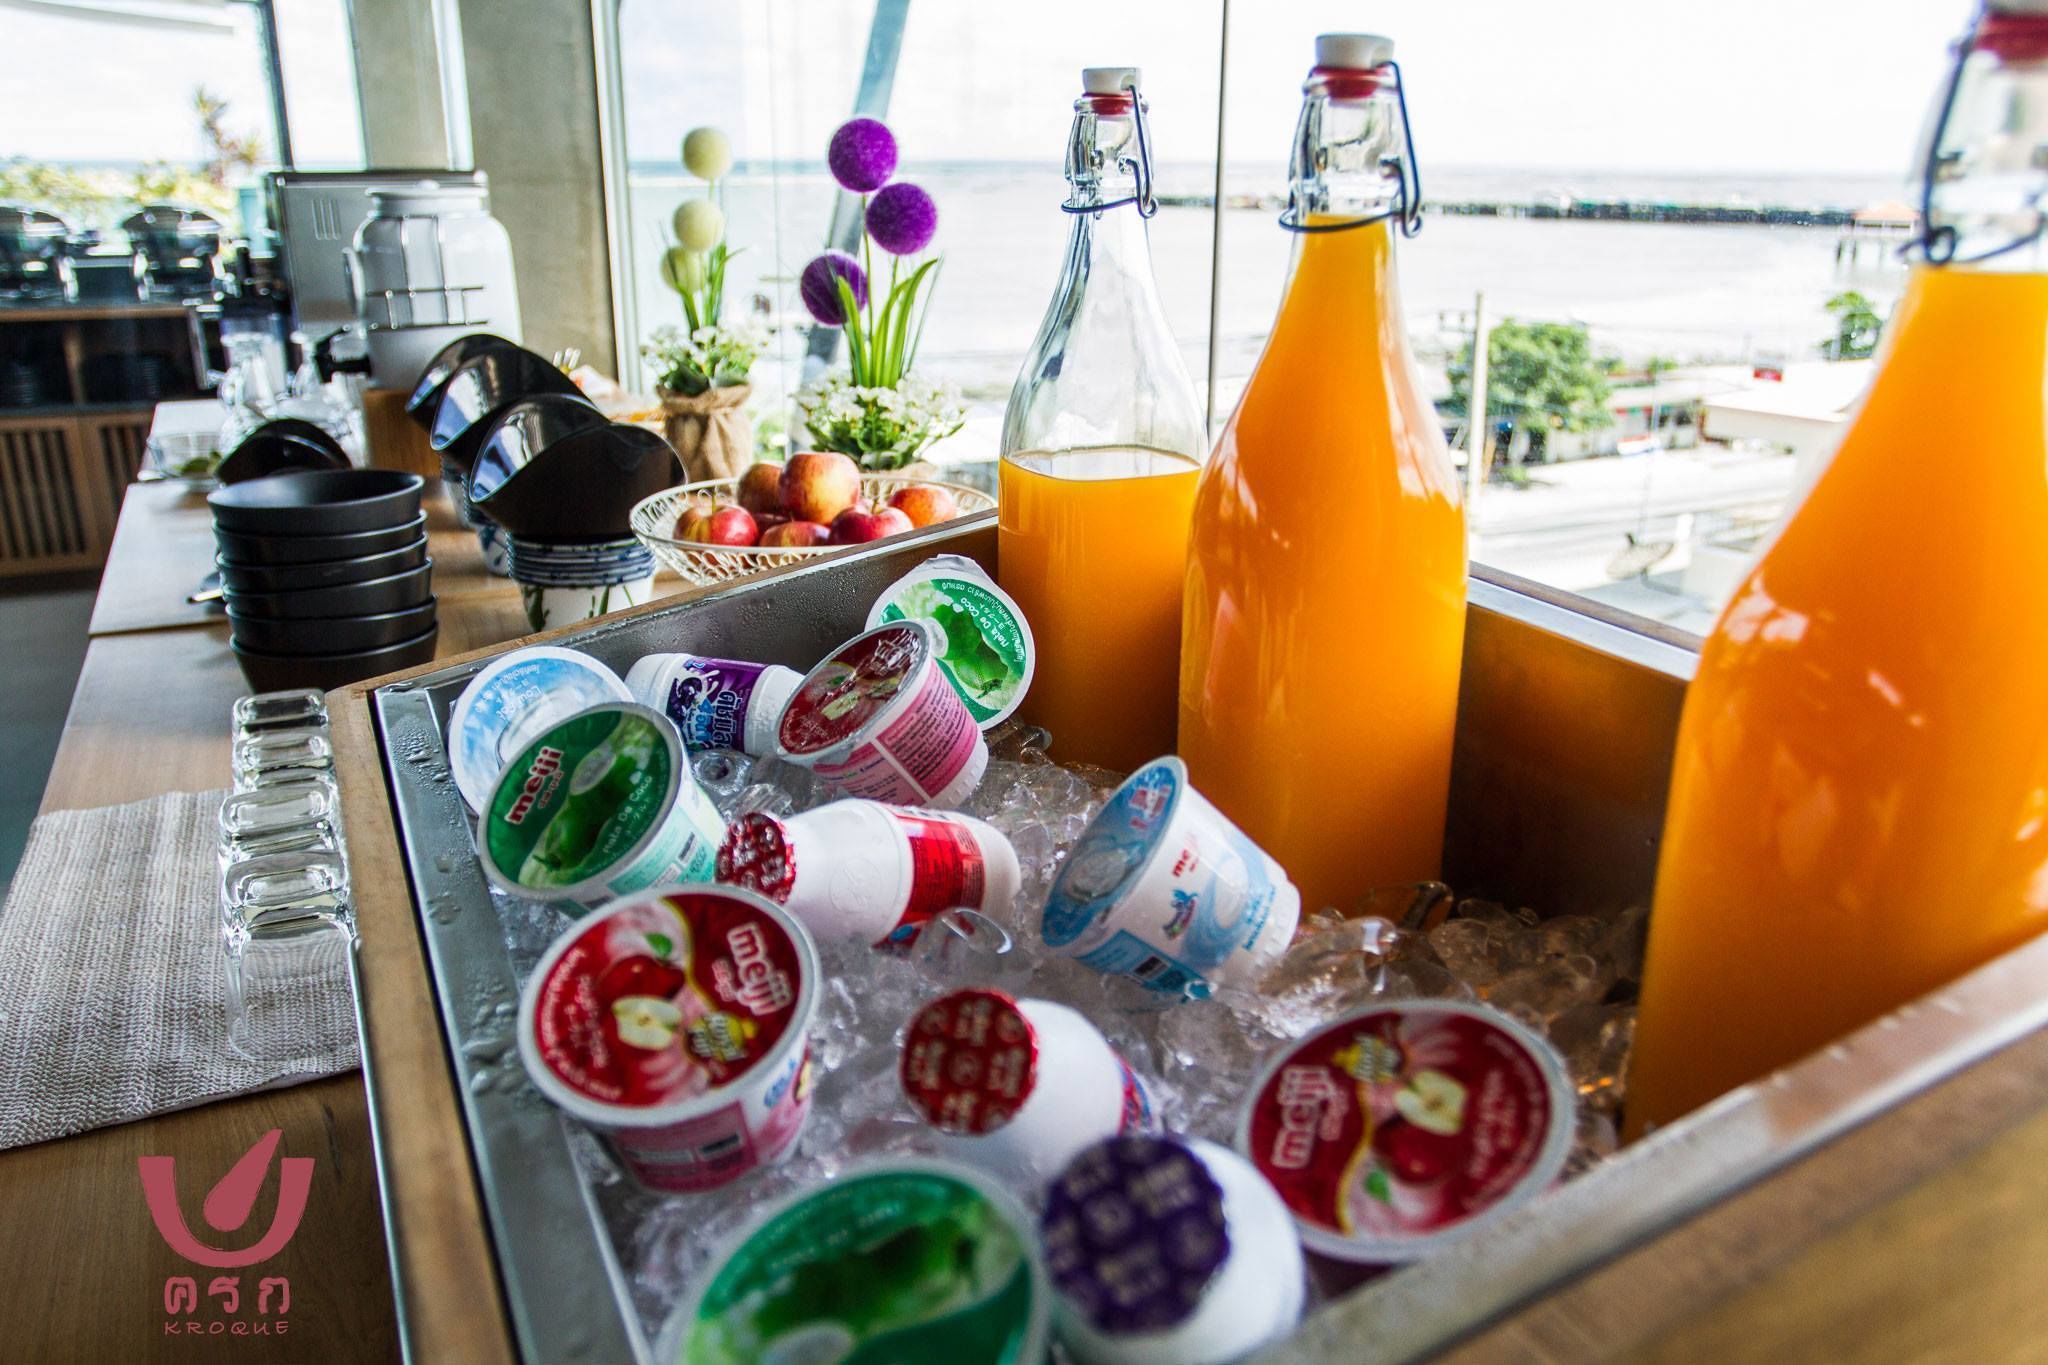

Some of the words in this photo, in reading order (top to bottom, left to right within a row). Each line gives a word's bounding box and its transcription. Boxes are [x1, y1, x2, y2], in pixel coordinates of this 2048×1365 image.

[960, 596, 980, 617] Coco
[979, 616, 992, 629] De
[991, 625, 1009, 648] Nata
[504, 746, 565, 825] meiji
[617, 806, 633, 822] De
[629, 775, 653, 802] Coco
[726, 921, 795, 1016] meiji
[1272, 1064, 1338, 1170] meiji
